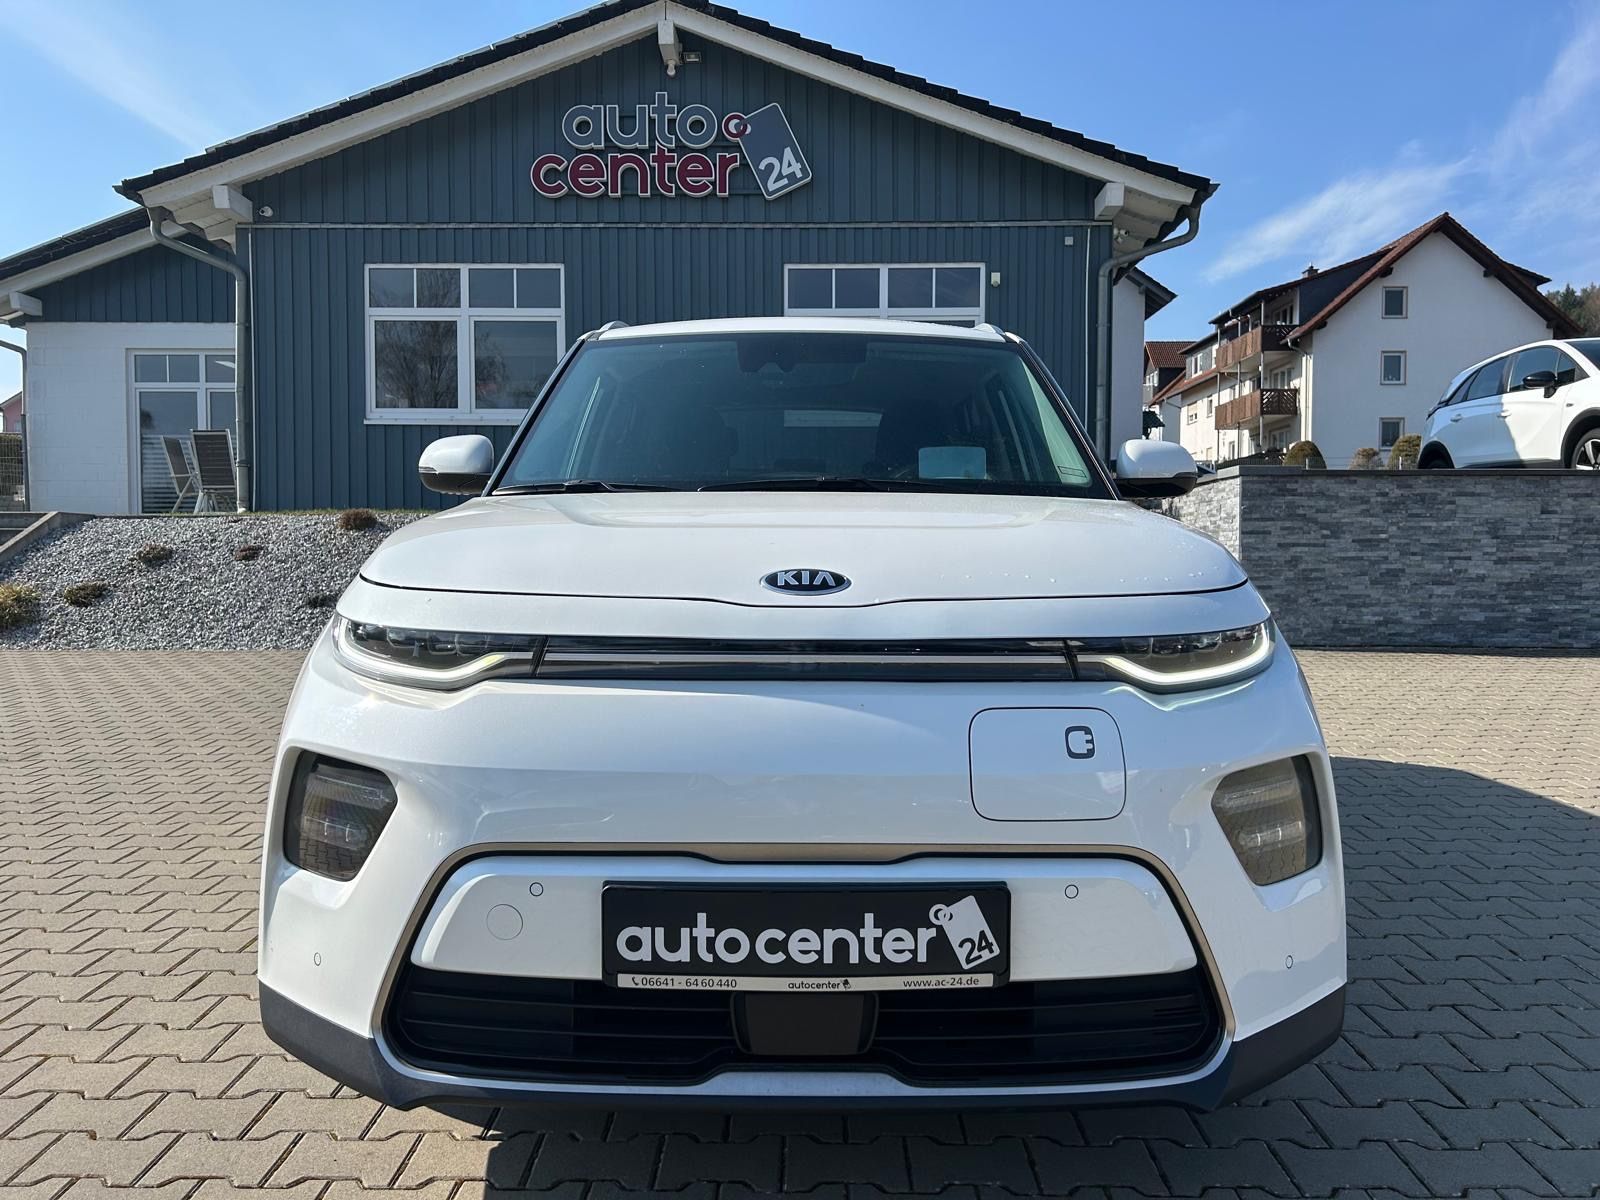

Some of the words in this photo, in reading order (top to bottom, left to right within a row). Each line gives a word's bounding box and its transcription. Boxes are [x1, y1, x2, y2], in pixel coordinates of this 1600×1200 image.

[561, 91, 718, 150] auto
[530, 141, 740, 198] center
[758, 146, 803, 192] 24
[777, 570, 836, 587] KIA
[616, 911, 937, 965] autocenter
[957, 929, 995, 966] 24
[641, 977, 675, 987] 06641
[787, 979, 841, 990] autocenter
[903, 976, 980, 988] www.ac-24.de
